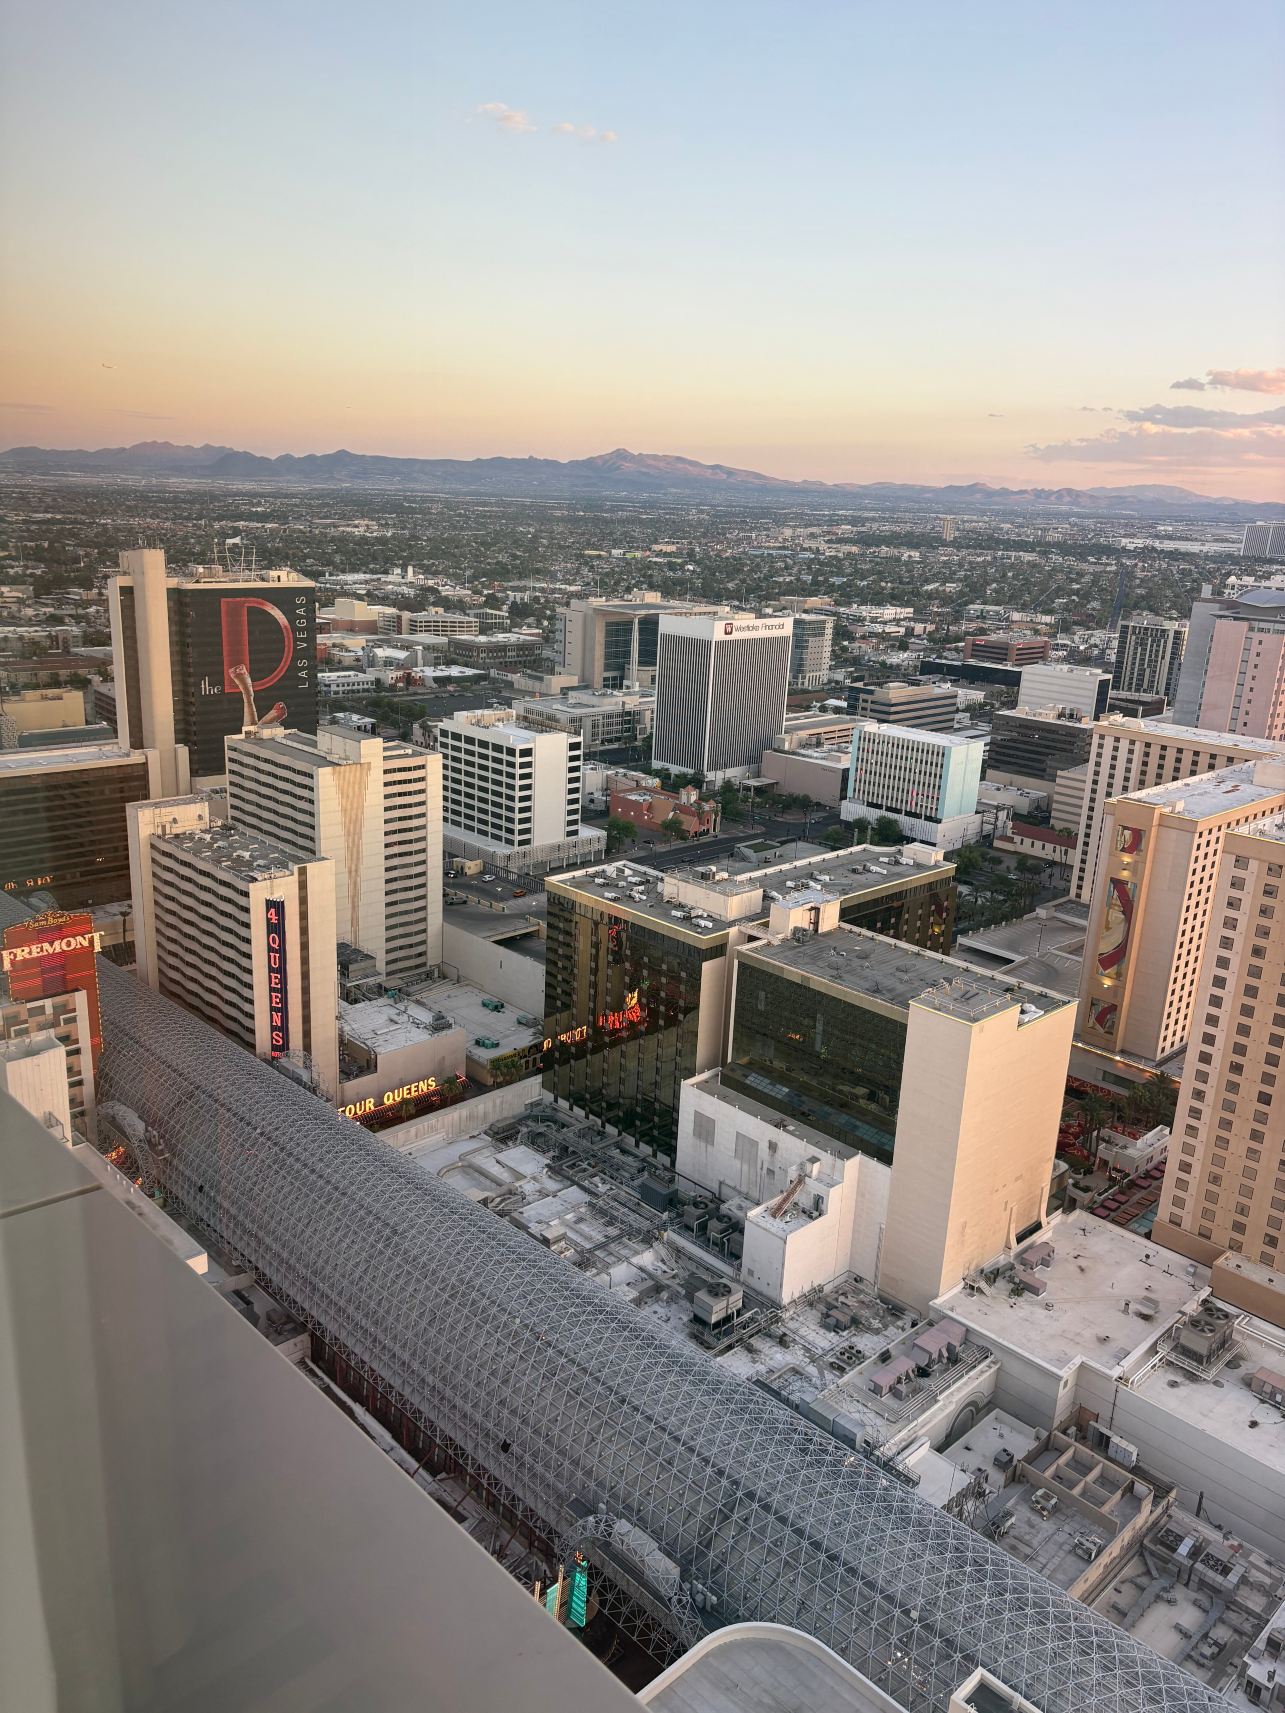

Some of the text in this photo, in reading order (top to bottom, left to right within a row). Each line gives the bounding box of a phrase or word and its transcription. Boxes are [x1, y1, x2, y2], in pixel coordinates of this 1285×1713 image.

[201, 598, 293, 695] the D
[295, 596, 309, 688] LAS VEGAS
[734, 622, 785, 633] Westlake Financial
[267, 908, 279, 923] 4
[0, 931, 105, 971] FREMONT
[269, 934, 283, 1045] QUEENS
[383, 1077, 436, 1104] QUEENS
